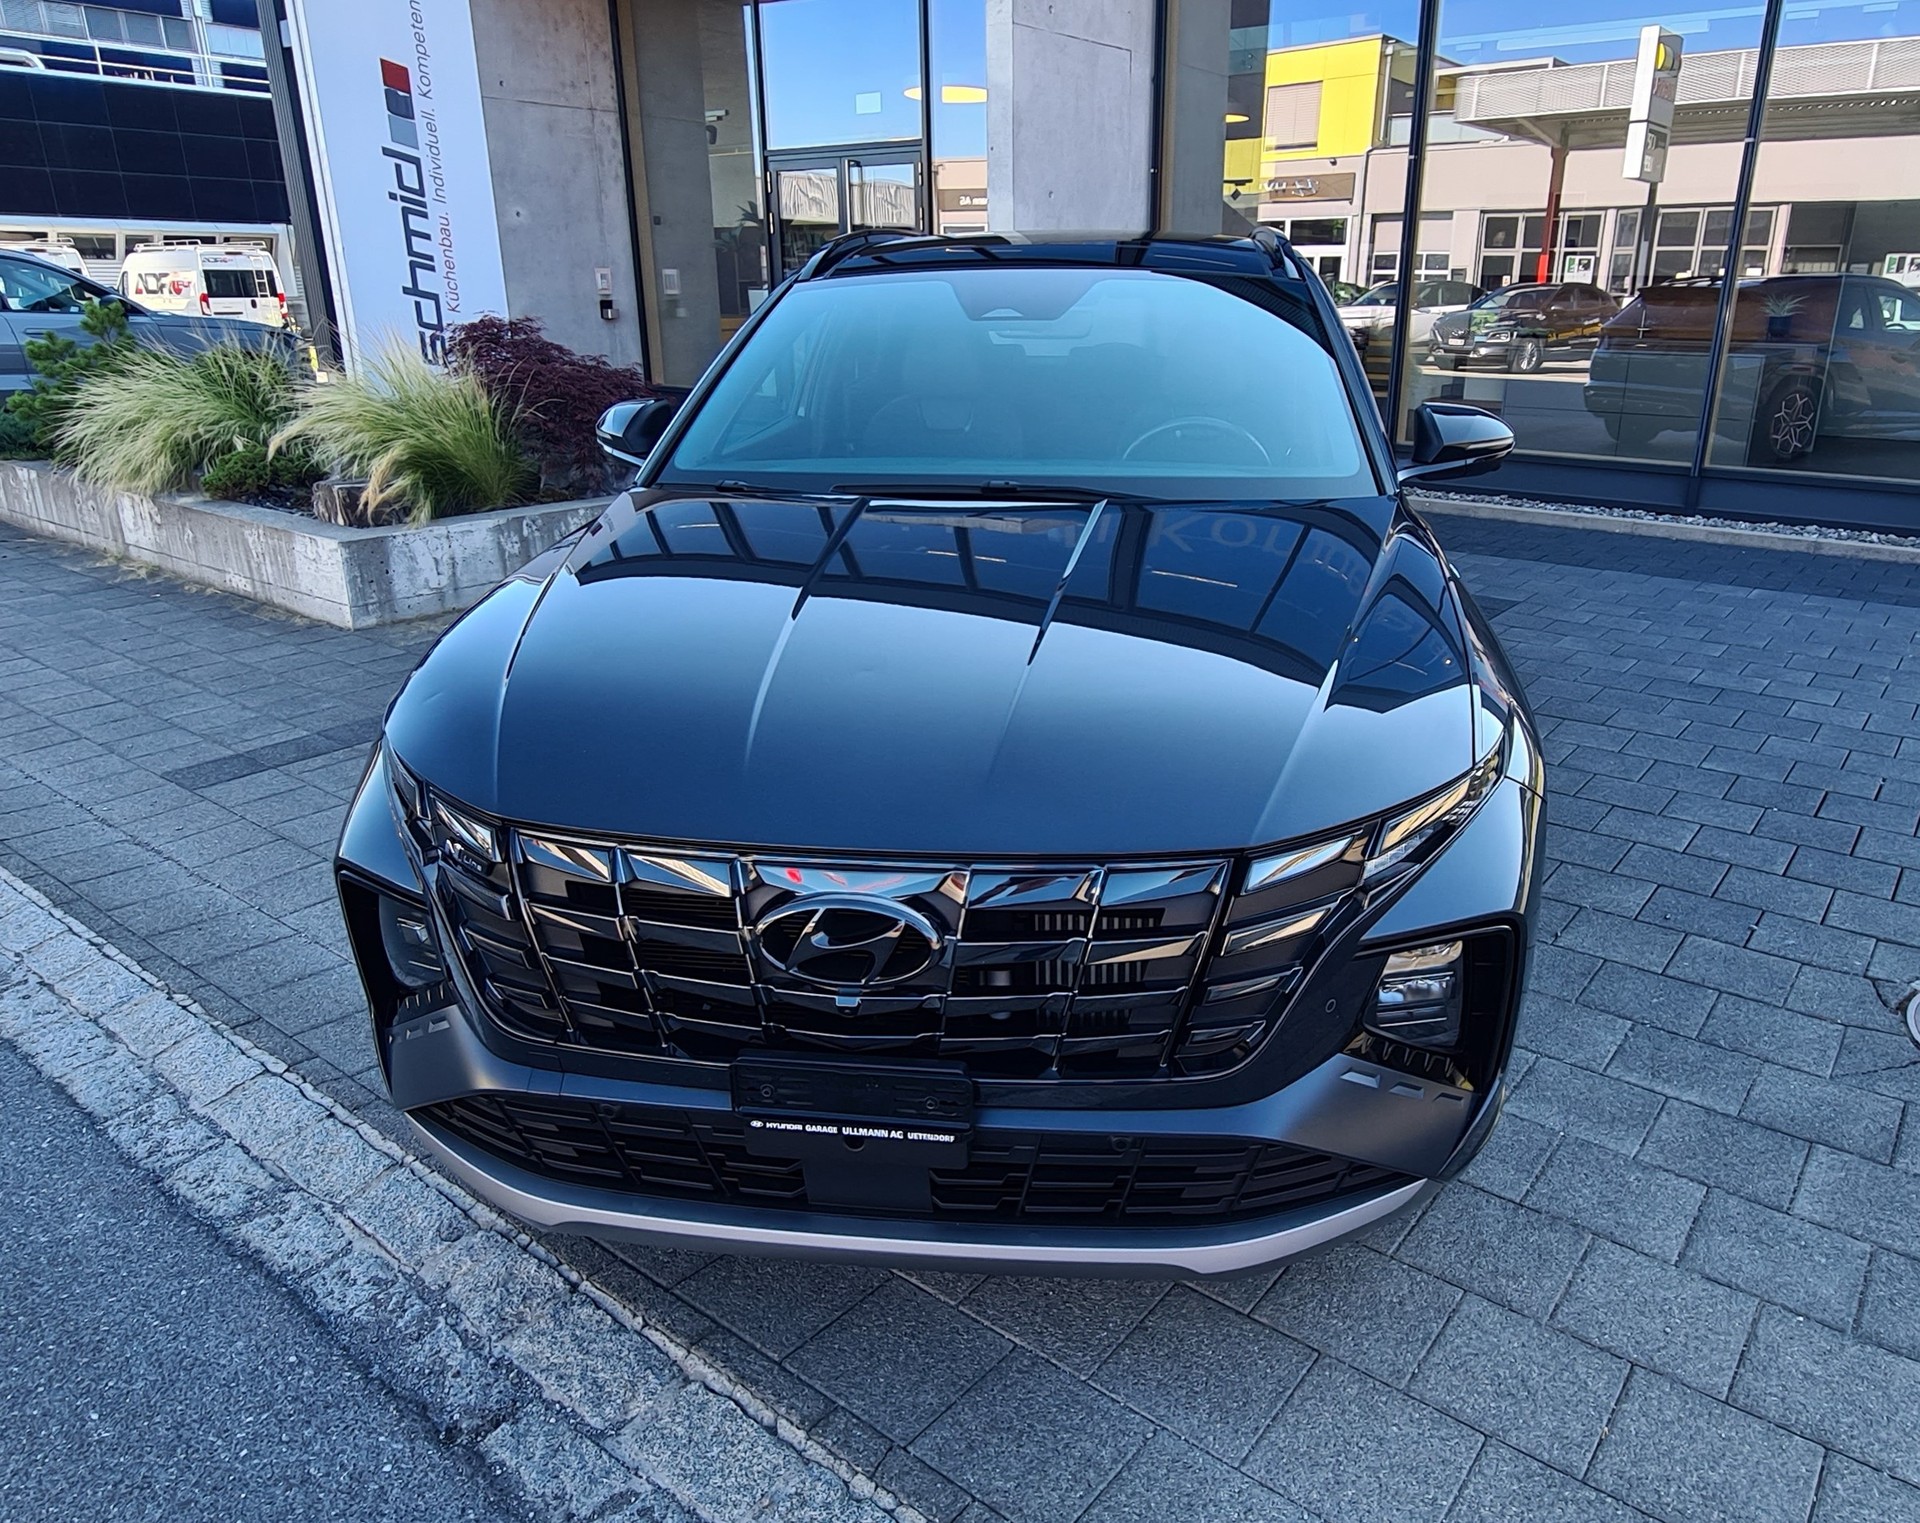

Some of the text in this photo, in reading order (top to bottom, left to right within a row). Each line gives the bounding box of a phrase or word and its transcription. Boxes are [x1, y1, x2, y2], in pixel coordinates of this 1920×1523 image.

[420, 108, 447, 205] Individuell.
[438, 212, 460, 313] Küchenbau.
[805, 1124, 838, 1134] GARAGE
[842, 1126, 888, 1138] ULLMANN
[890, 1129, 904, 1139] AG
